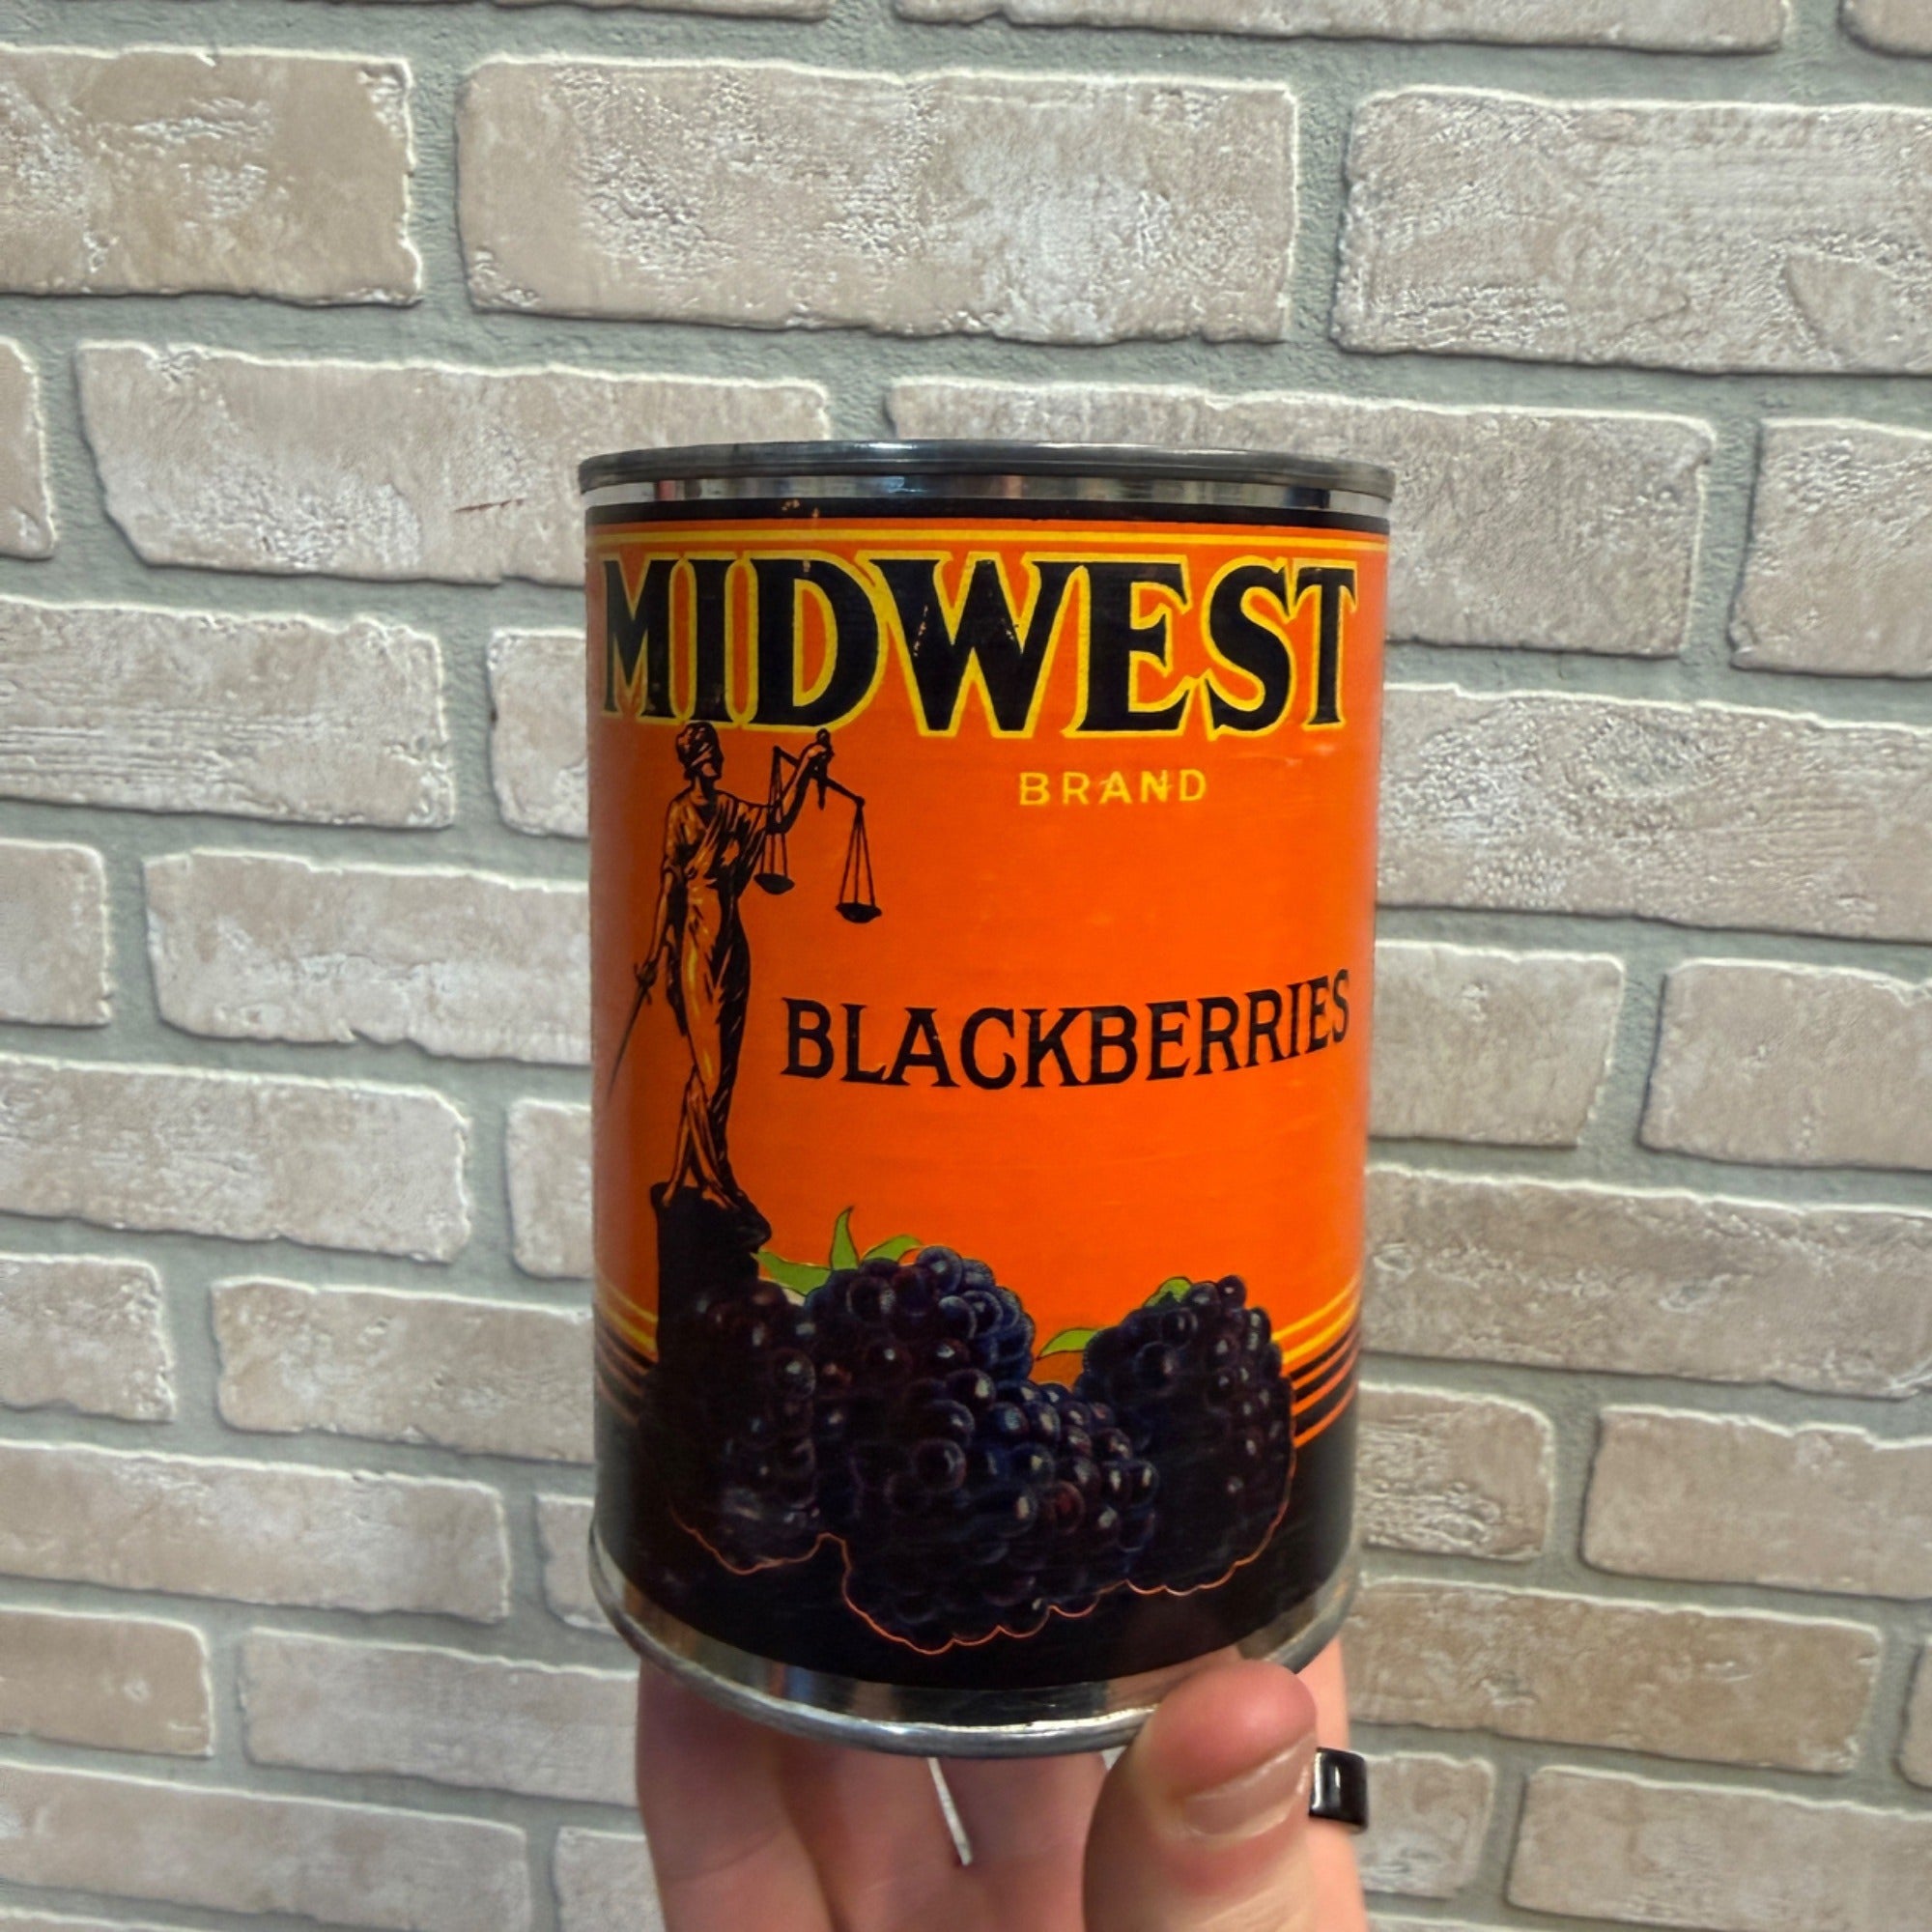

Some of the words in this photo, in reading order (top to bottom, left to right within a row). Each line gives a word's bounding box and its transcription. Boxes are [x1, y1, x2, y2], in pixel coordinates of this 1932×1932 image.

[601, 550, 1357, 739] MIDWEST
[1018, 768, 1208, 808] BRAND
[781, 969, 1350, 1091] BLACKBERRIES
